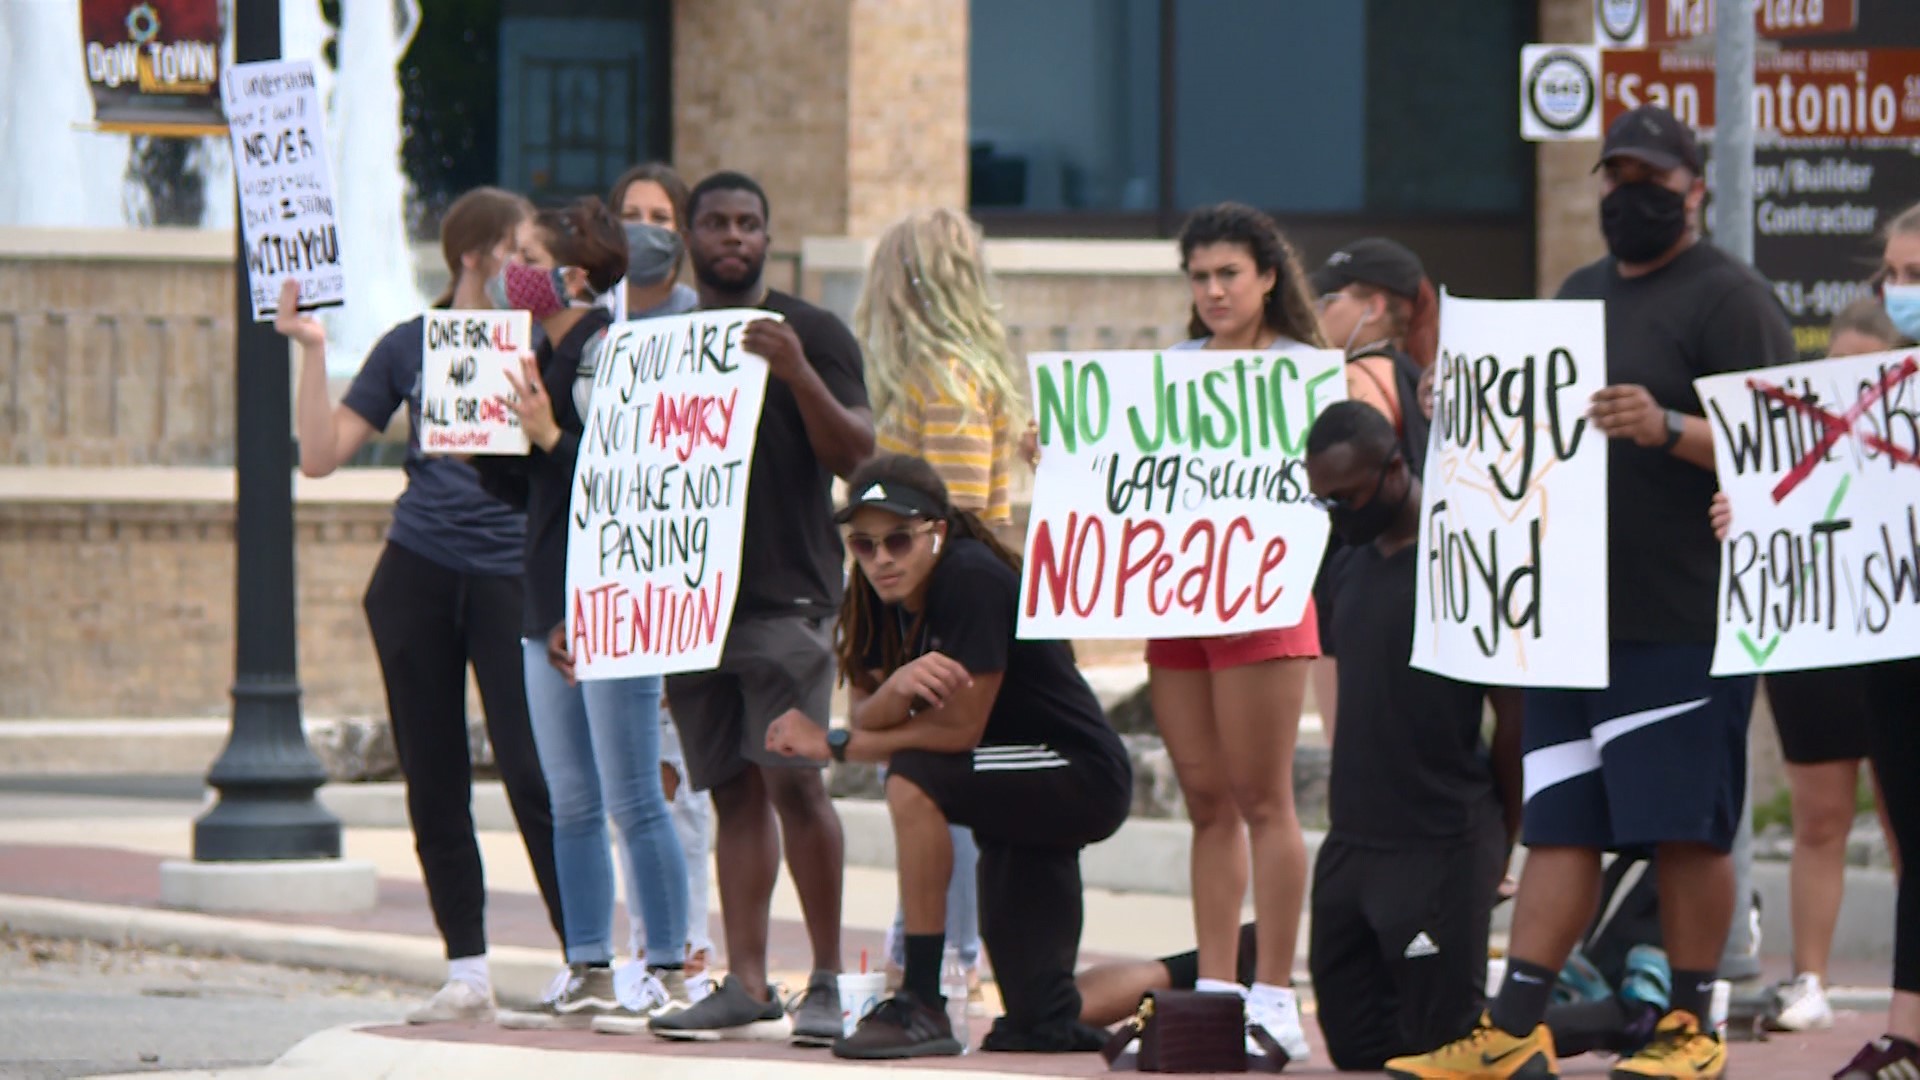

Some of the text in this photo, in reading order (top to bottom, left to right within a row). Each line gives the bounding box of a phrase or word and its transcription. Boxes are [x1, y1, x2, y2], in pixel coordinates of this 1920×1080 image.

[1665, 0, 1824, 37] Mai laza
[1750, 72, 1897, 134] ntonio
[242, 125, 316, 167] NEVER
[1757, 201, 1877, 236] Contractor
[245, 233, 301, 275] WITH
[427, 317, 518, 352] ONE FOR ALL
[597, 331, 633, 388] IF
[675, 319, 744, 375] ARE
[445, 354, 477, 387] AND
[422, 393, 451, 426] ALL
[454, 396, 479, 423] FOR
[587, 402, 651, 457] NOT
[1036, 358, 1112, 455] NO
[575, 458, 743, 531] YOU ARE NOT
[1024, 510, 1107, 619] NO
[1879, 503, 1920, 605] W
[571, 570, 724, 667] ATTENTION
